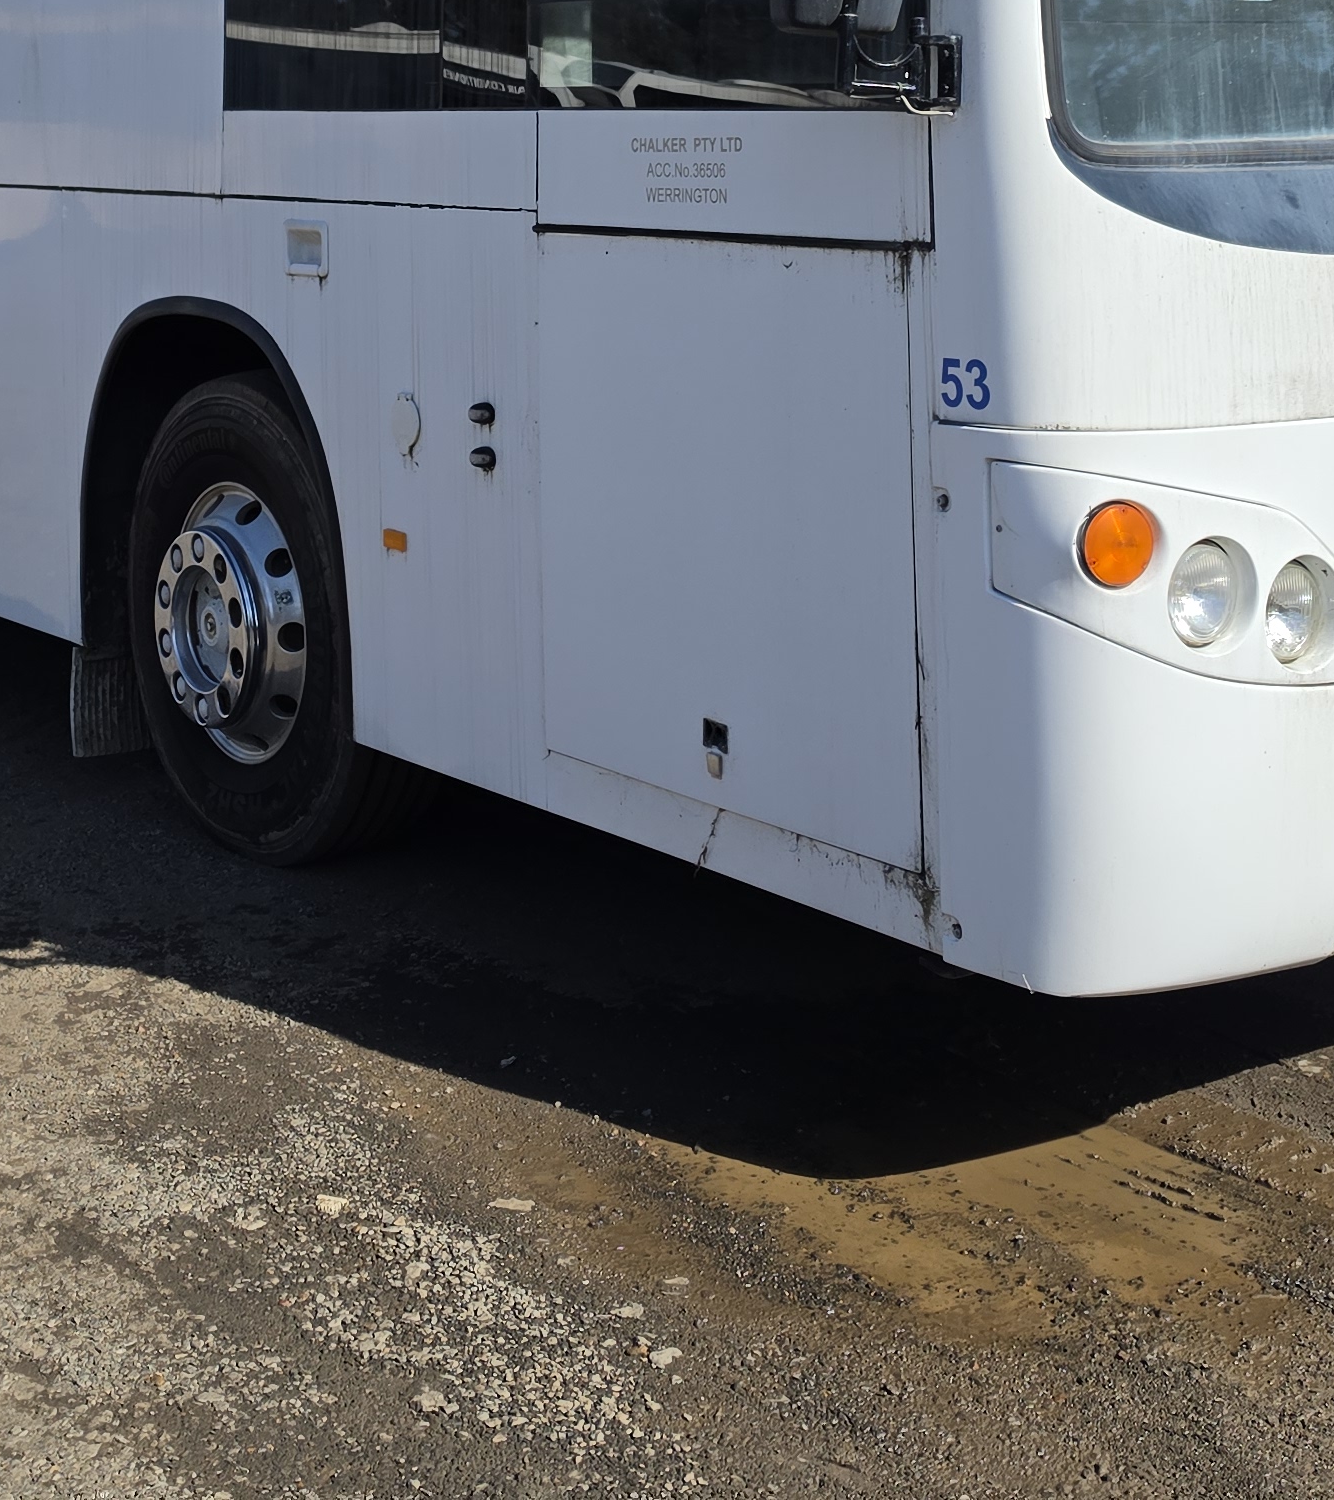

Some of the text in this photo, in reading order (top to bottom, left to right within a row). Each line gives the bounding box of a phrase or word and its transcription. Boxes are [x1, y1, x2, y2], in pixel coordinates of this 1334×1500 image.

[631, 137, 743, 153] CHALKER PTY LTD
[645, 187, 727, 203] WERRINGTON
[941, 358, 990, 410] 53
[158, 425, 225, 489] Continental
